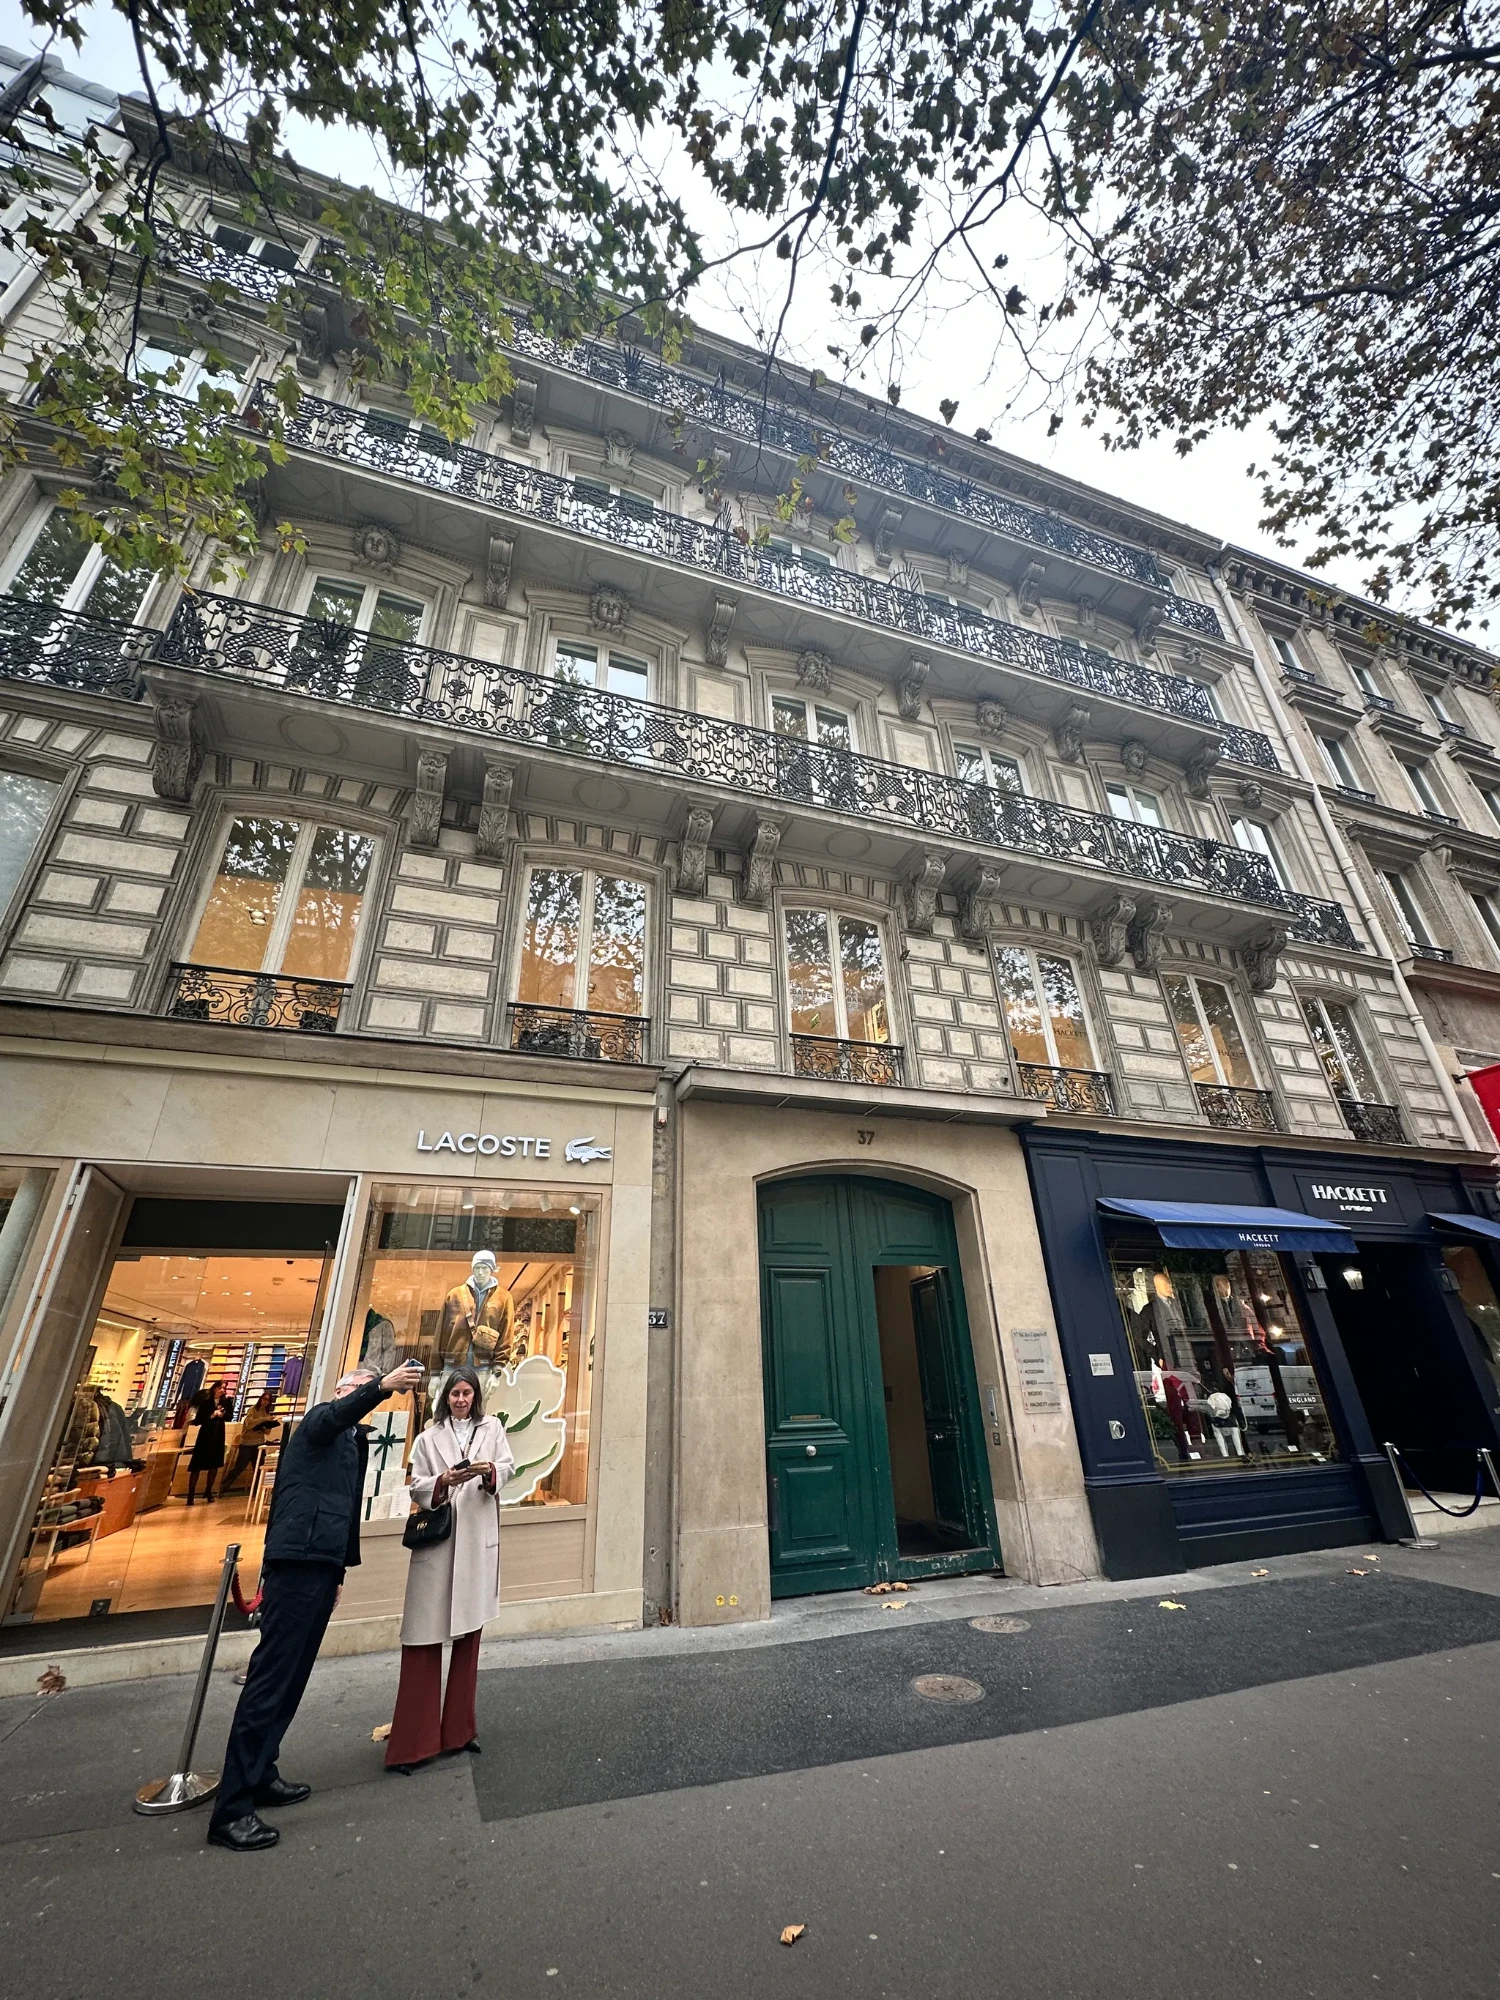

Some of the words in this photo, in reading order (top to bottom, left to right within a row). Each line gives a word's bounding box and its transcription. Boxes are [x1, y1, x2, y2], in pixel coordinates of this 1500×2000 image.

[1053, 1028, 1087, 1038] HACKETT
[417, 1130, 551, 1158] LACOSTE
[857, 1130, 875, 1145] 37
[1312, 1184, 1387, 1202] HACKETT
[1238, 1233, 1279, 1242] HACKETT
[648, 1311, 666, 1325] 37
[168, 1352, 177, 1367] PETIT
[240, 1356, 250, 1383] ORIGINAL
